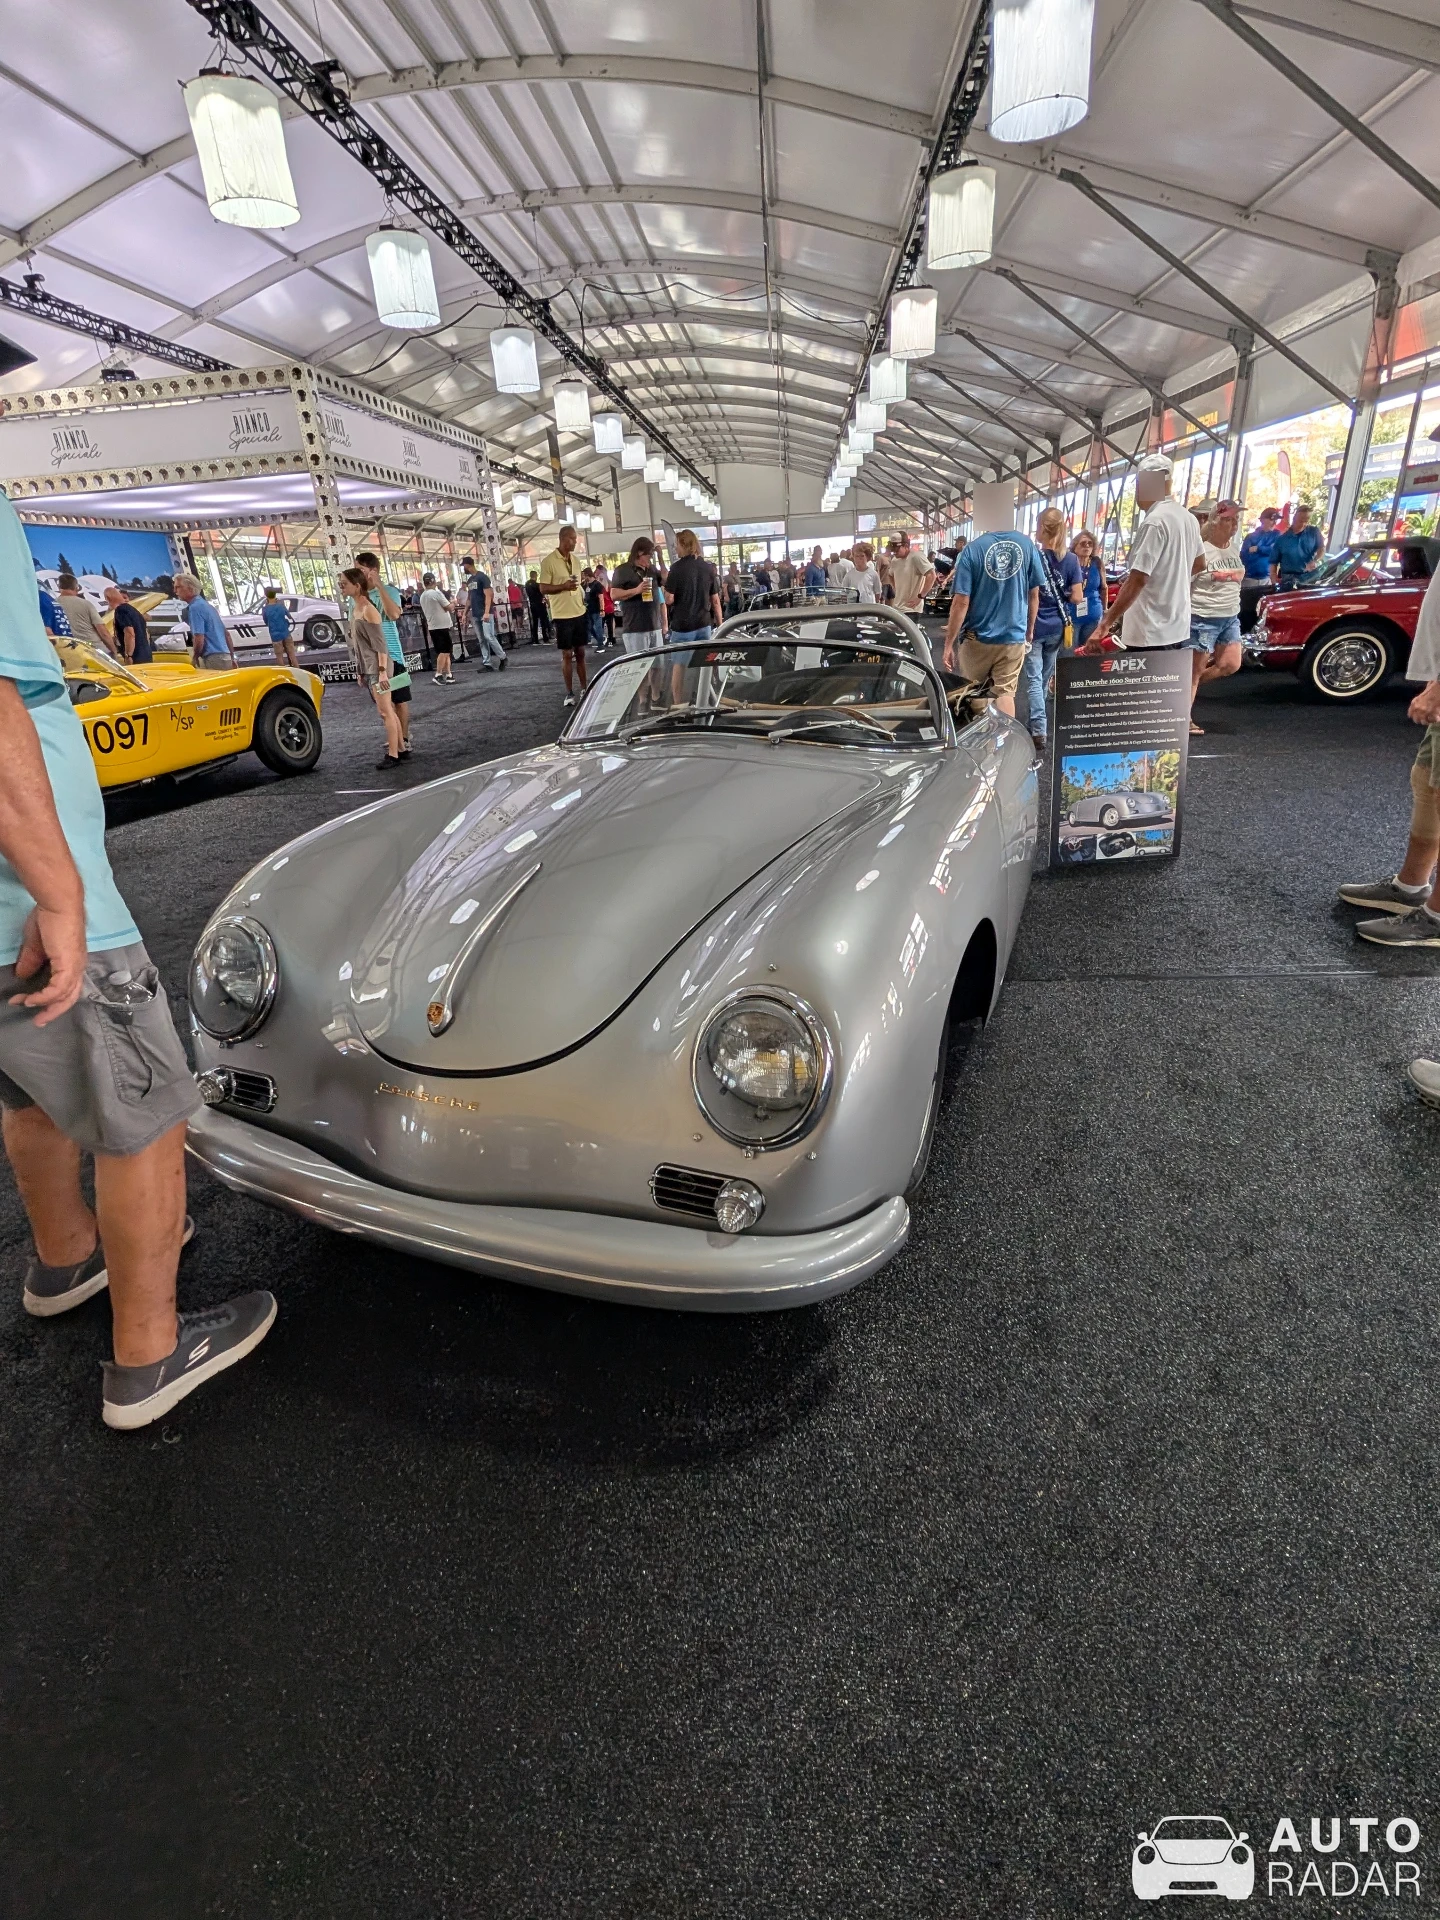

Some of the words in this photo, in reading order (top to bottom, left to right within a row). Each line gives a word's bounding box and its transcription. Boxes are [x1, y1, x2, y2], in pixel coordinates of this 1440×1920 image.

[233, 412, 270, 435] BIANCO
[52, 429, 90, 452] BIANCO
[229, 426, 282, 453] Speciale
[51, 443, 102, 469] Speciale
[714, 652, 748, 661] APEX
[1111, 658, 1147, 672] APEX
